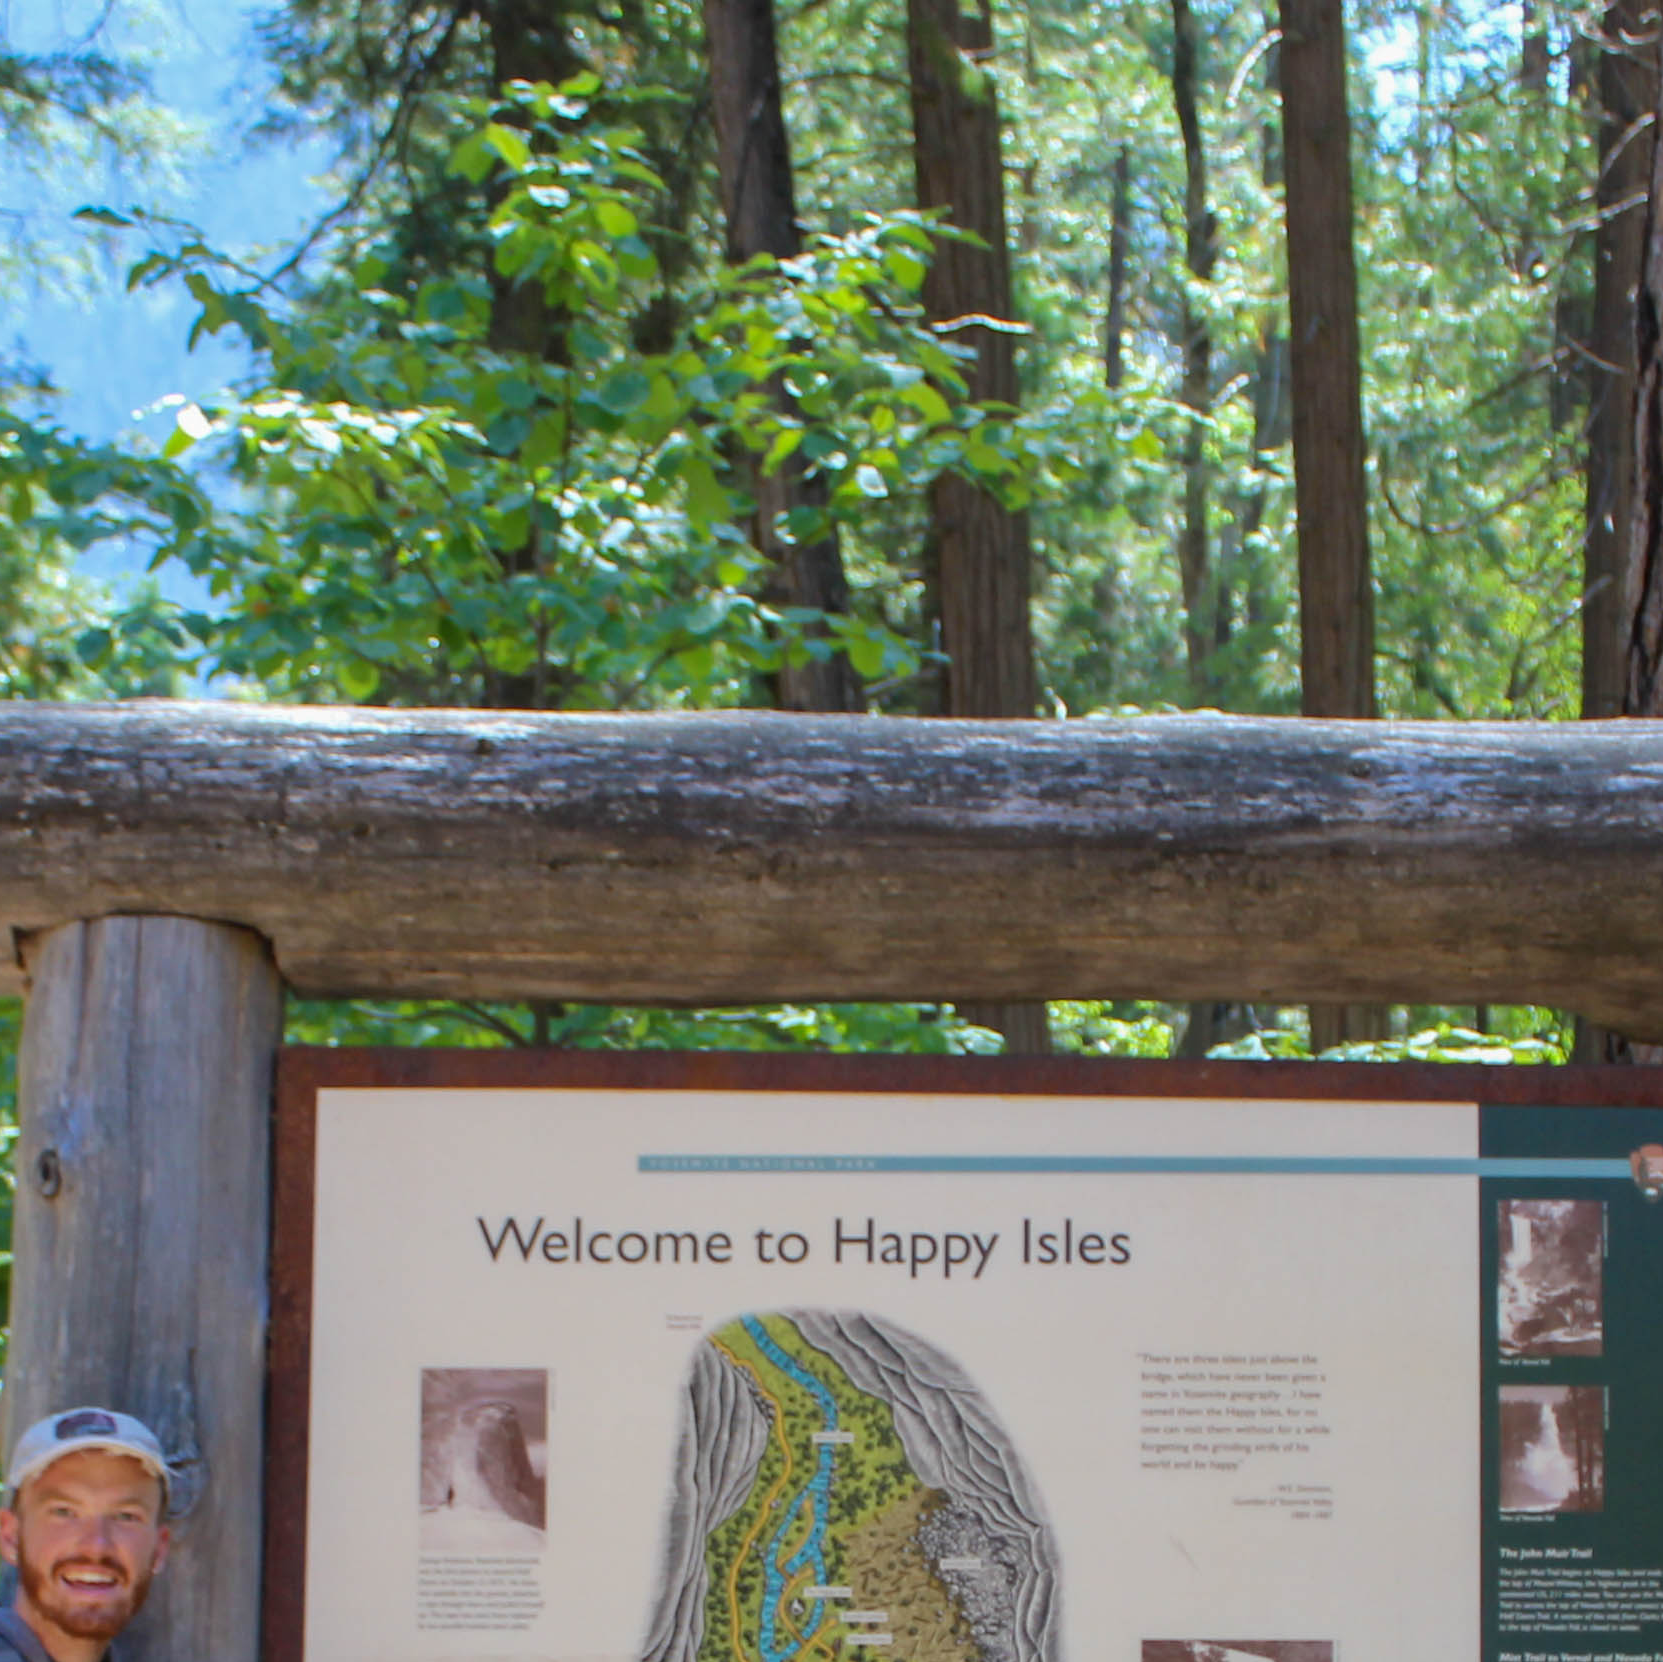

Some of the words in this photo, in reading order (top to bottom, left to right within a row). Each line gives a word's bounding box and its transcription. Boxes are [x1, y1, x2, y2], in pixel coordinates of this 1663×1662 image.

[651, 1157, 729, 1170] YOSEMITE
[738, 1157, 824, 1170] NATIONAL
[835, 1157, 876, 1170] PARK
[477, 1217, 732, 1266] Welcome
[754, 1223, 809, 1266] to
[834, 1217, 1000, 1280] Happy
[1023, 1217, 1132, 1266] Isles
[1500, 1547, 1517, 1560] The
[1520, 1547, 1543, 1560] John
[1545, 1547, 1569, 1560] Muir
[1571, 1547, 1593, 1560] Trail
